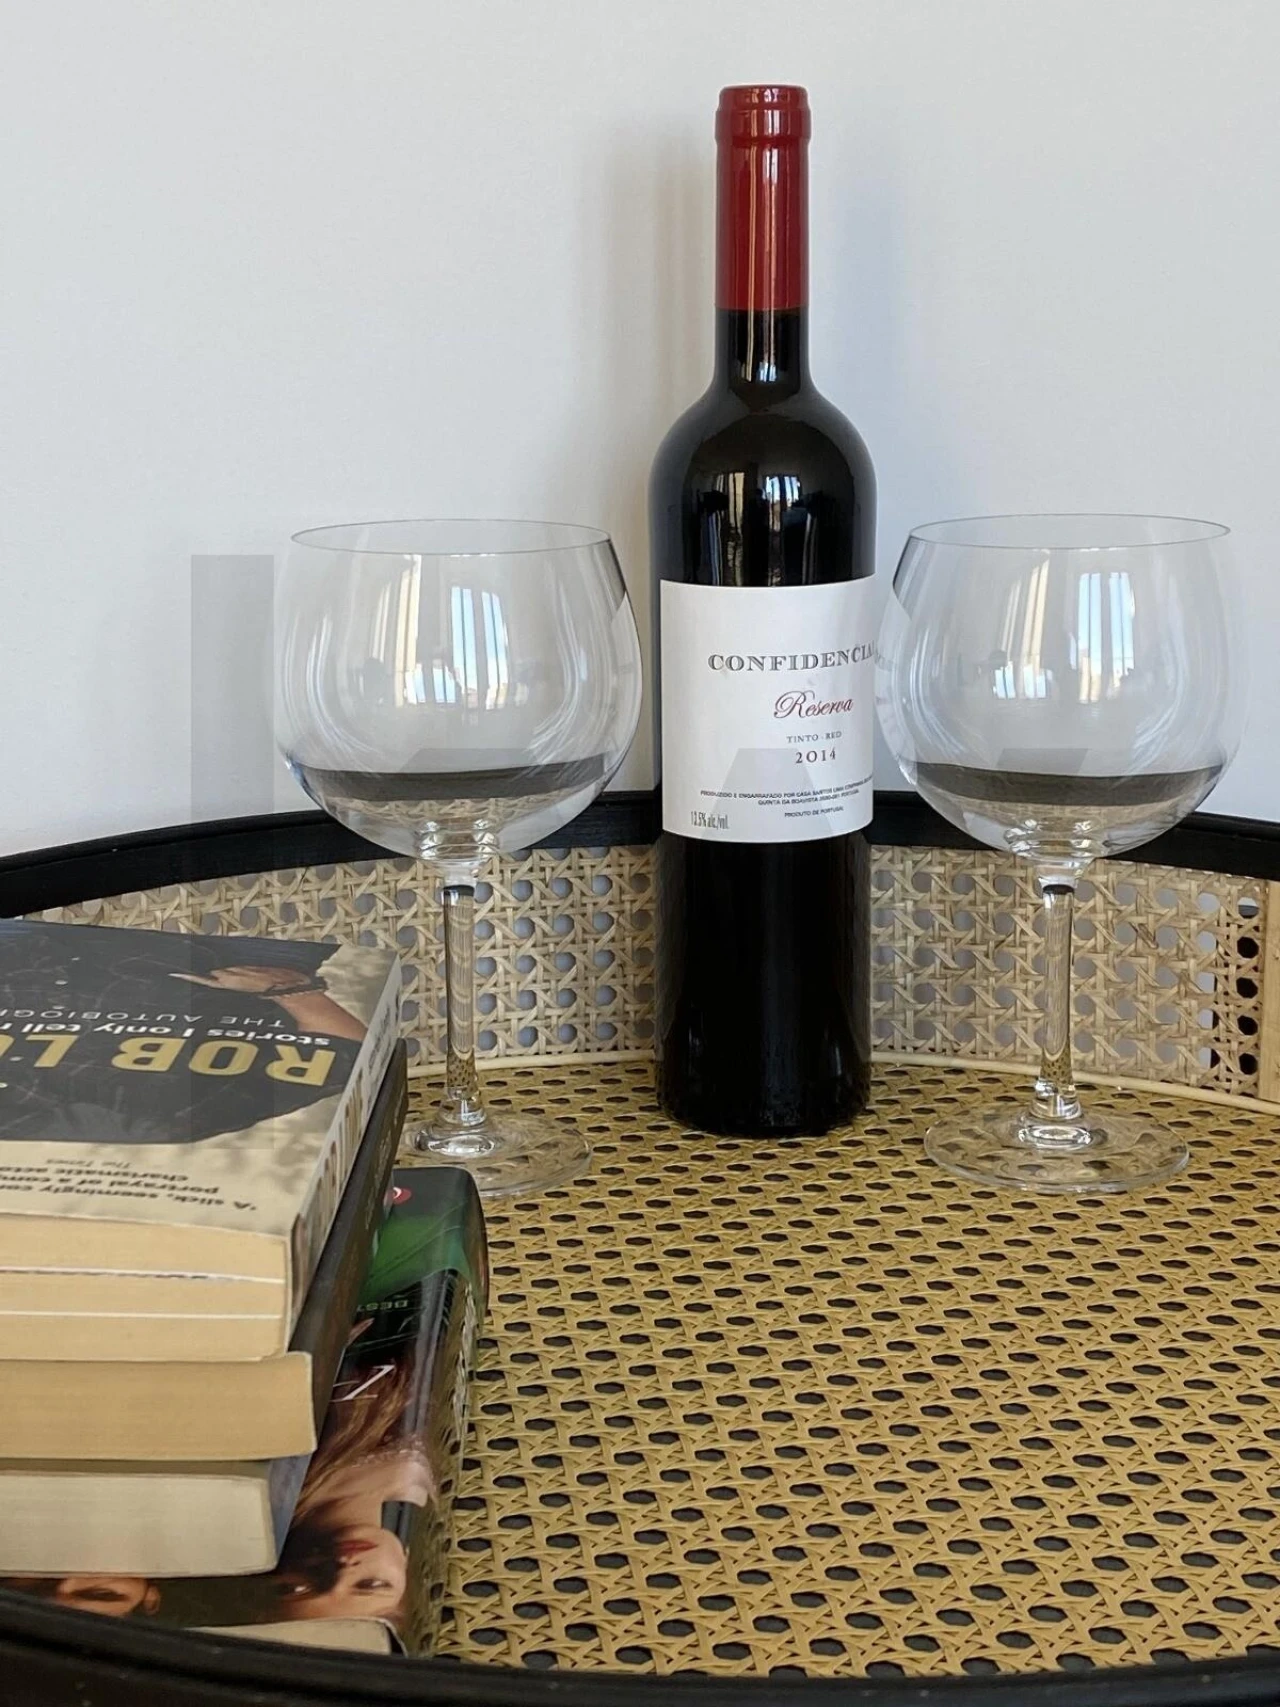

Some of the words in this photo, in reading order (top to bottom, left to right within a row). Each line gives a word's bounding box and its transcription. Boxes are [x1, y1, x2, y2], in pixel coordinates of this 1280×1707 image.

[773, 690, 853, 719] Reserva
[786, 733, 819, 744] TINTO
[825, 731, 842, 740] RED
[795, 747, 836, 764] 2014
[700, 789, 733, 798] PRODUZIDO
[791, 796, 818, 805] BOAVISTA
[784, 810, 812, 818] PRODUTO
[820, 805, 844, 814] PORTUGAL
[21, 1022, 82, 1033] tell
[219, 1015, 285, 1028] THE
[93, 1022, 171, 1035] only
[182, 1027, 196, 1038] I
[207, 1029, 331, 1047] stories
[0, 1033, 80, 1068] L
[111, 1037, 337, 1086] ROB
[0, 1174, 51, 1183] com
[54, 1168, 189, 1183] charismatic
[77, 1178, 102, 1186] of
[38, 1184, 159, 1200] seemingly
[108, 1180, 219, 1196] portrayal
